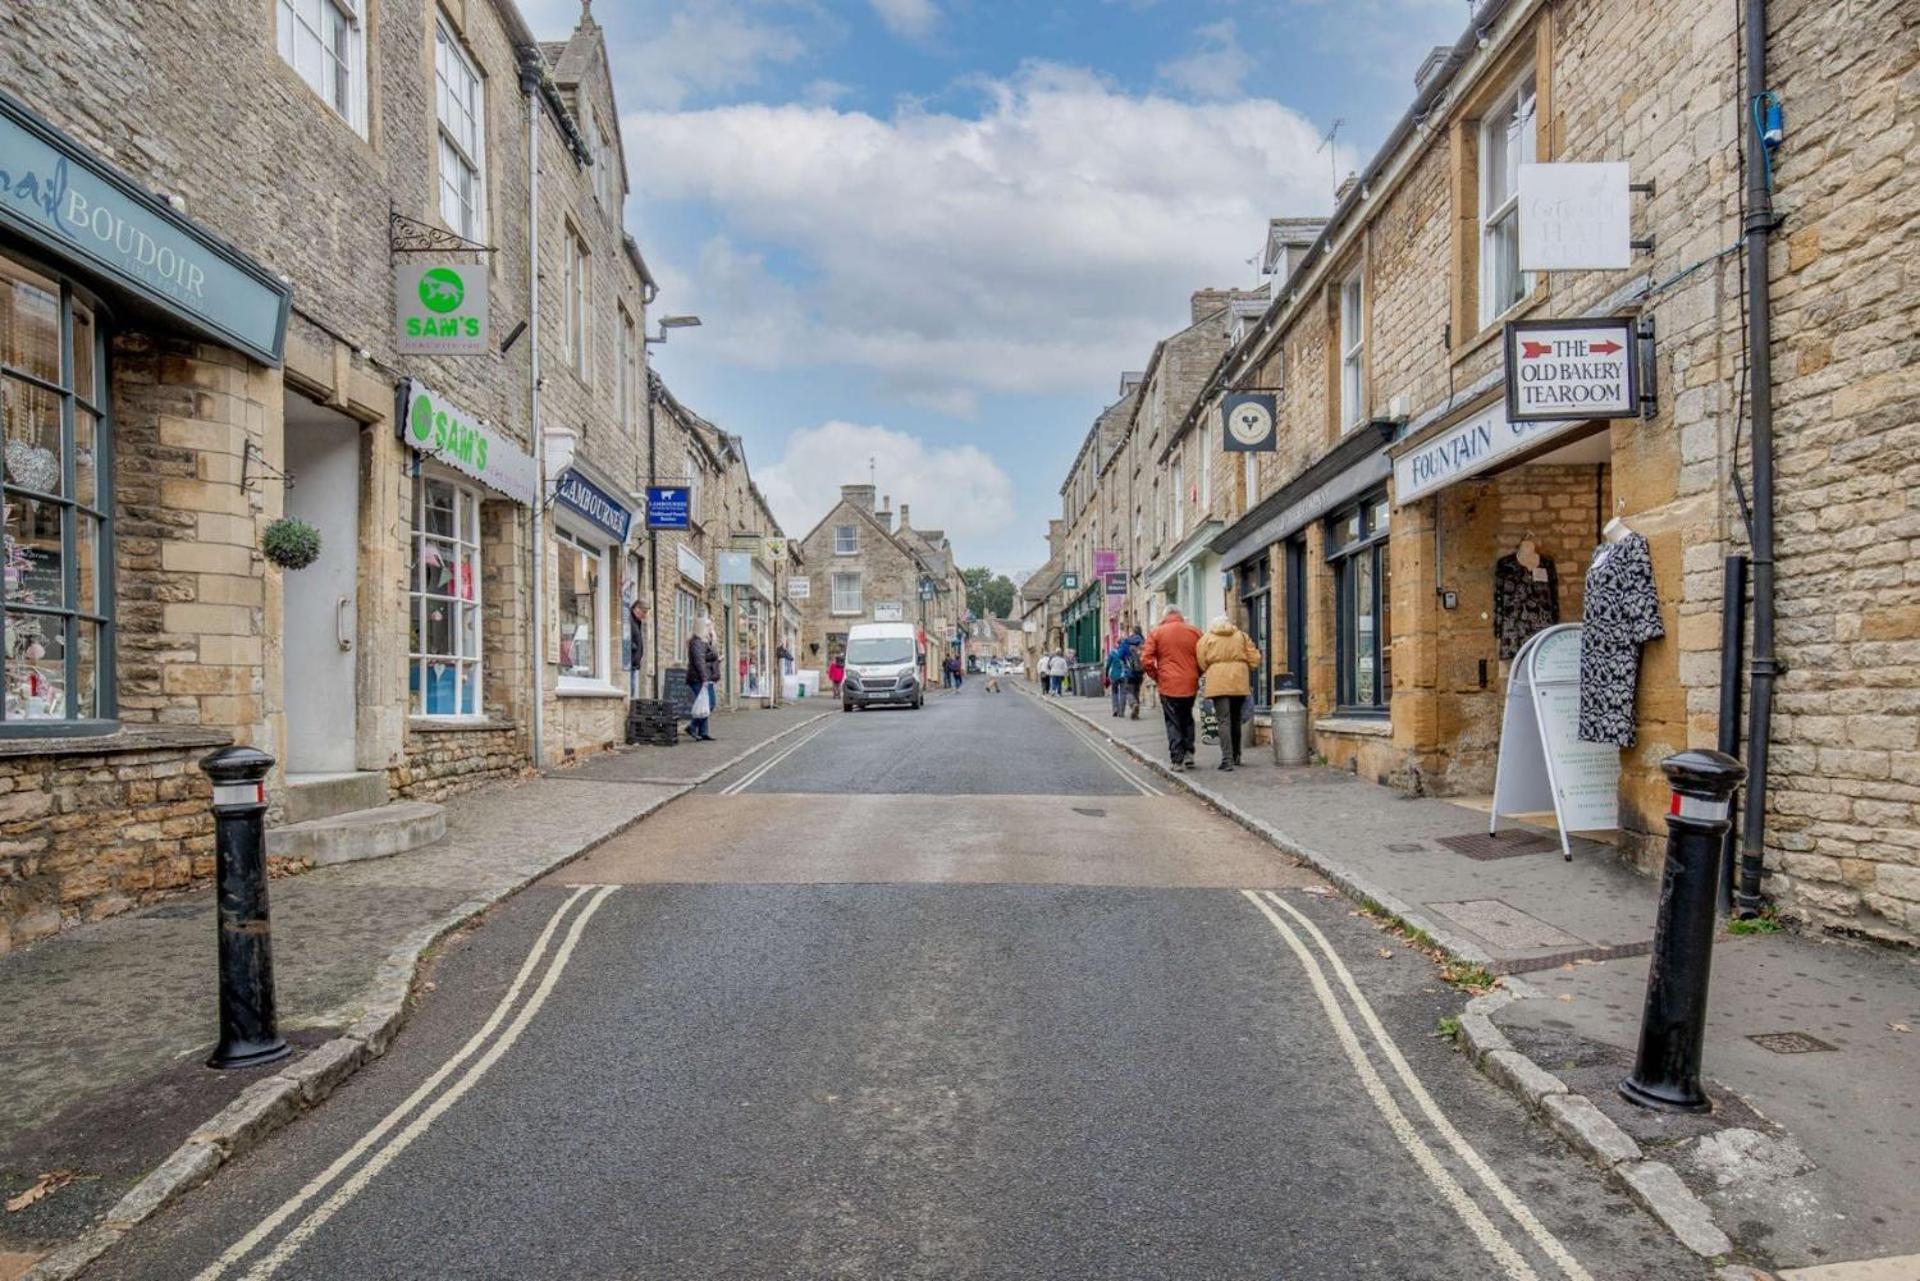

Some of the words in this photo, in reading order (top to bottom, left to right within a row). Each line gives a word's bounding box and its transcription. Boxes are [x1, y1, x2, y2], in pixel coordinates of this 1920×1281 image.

[67, 189, 205, 297] BOUDOIR
[406, 316, 480, 337] SAM'S
[1552, 339, 1589, 358] THE
[1521, 363, 1557, 382] OLD
[1560, 361, 1623, 381] BAKERY
[1524, 384, 1621, 404] TEAROOM
[434, 410, 489, 471] SAM'S
[1412, 420, 1493, 487] FOUNTAIN
[560, 473, 625, 535] LAMBOURNES
